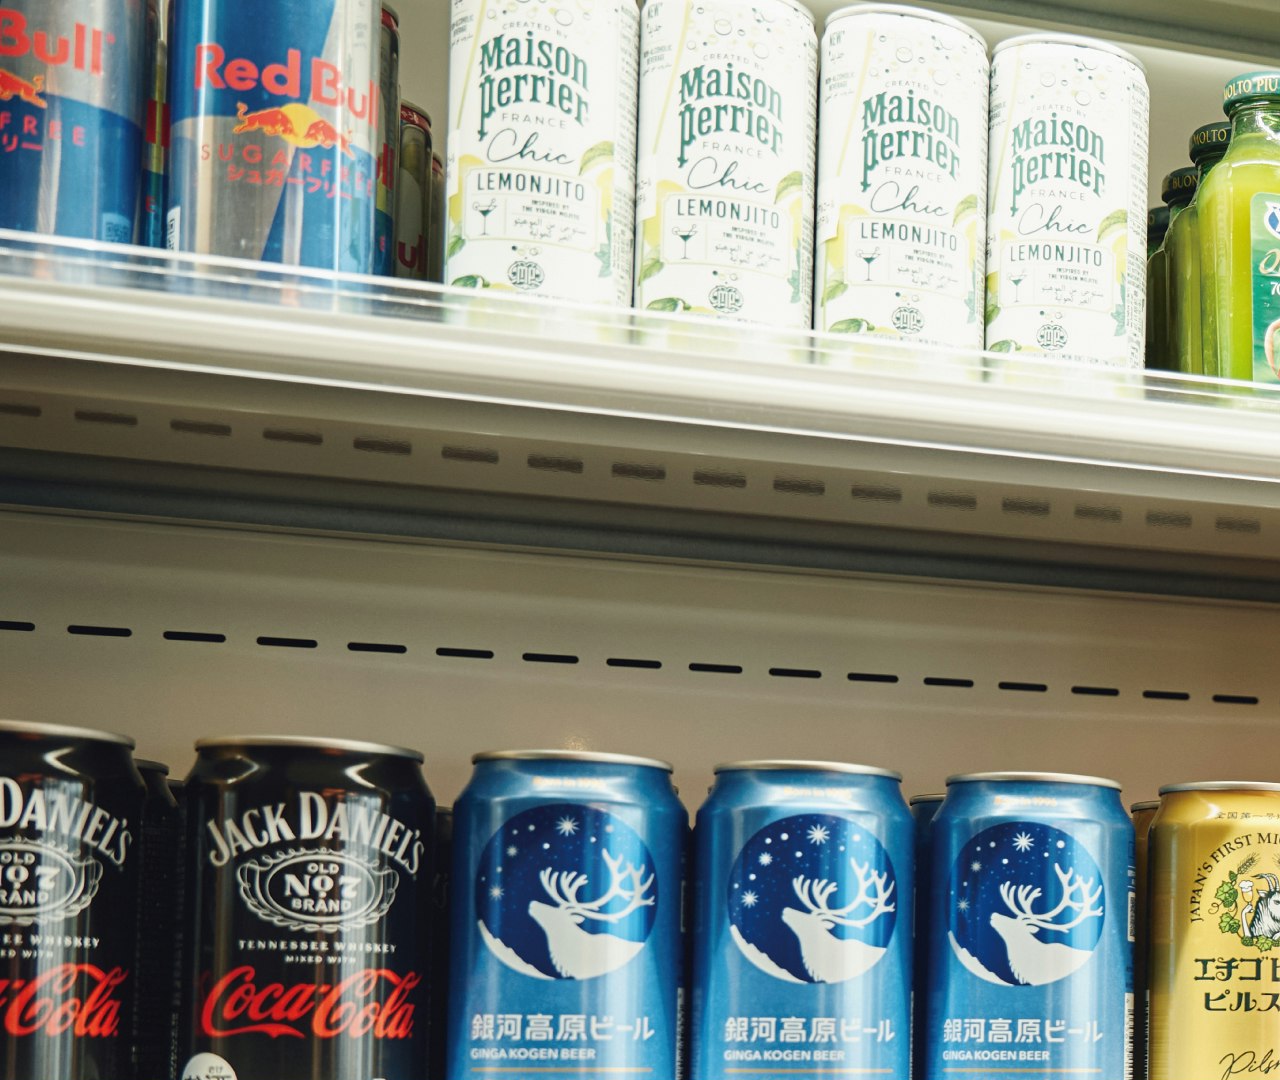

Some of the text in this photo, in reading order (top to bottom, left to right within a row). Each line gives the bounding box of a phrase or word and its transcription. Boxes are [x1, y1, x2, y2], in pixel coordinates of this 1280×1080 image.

[195, 44, 301, 98] Red
[479, 31, 590, 91] Maison
[679, 62, 782, 122] Maison
[502, 113, 566, 129] FRANCE
[862, 89, 960, 147] Maison
[486, 128, 575, 165] Chic
[702, 141, 763, 159] FRANCE
[1011, 113, 1105, 165] Maison
[227, 163, 353, 199] シュガーフリー
[478, 172, 584, 201] LEMONJITO
[885, 167, 943, 183] FRANCE
[1031, 189, 1085, 201] FRANCE
[678, 199, 779, 229] LEMONJITO
[861, 222, 956, 251] LEMONJITO
[1011, 244, 1102, 266] LEMONJITO
[207, 791, 425, 875] JACK DANIEL'S
[307, 862, 339, 874] OLD
[1191, 864, 1214, 922] JAPAN'S
[1212, 833, 1253, 866] FIRST
[292, 898, 352, 913] BRAND
[239, 940, 397, 954] TENNESSEE WHISKEY
[285, 955, 356, 964] MIXED WITH
[202, 964, 422, 1039] Coca-Cola
[471, 1015, 655, 1043] 銀河高原ビール
[725, 1017, 895, 1044] 銀河高原ビール
[944, 1018, 1102, 1043] 銀河高原ビール
[471, 1048, 595, 1060] GINGA KOGEN BEER
[724, 1050, 845, 1062] GINGA KOGEN BEER
[943, 1050, 1049, 1061] GINGA KOGEN BEER
